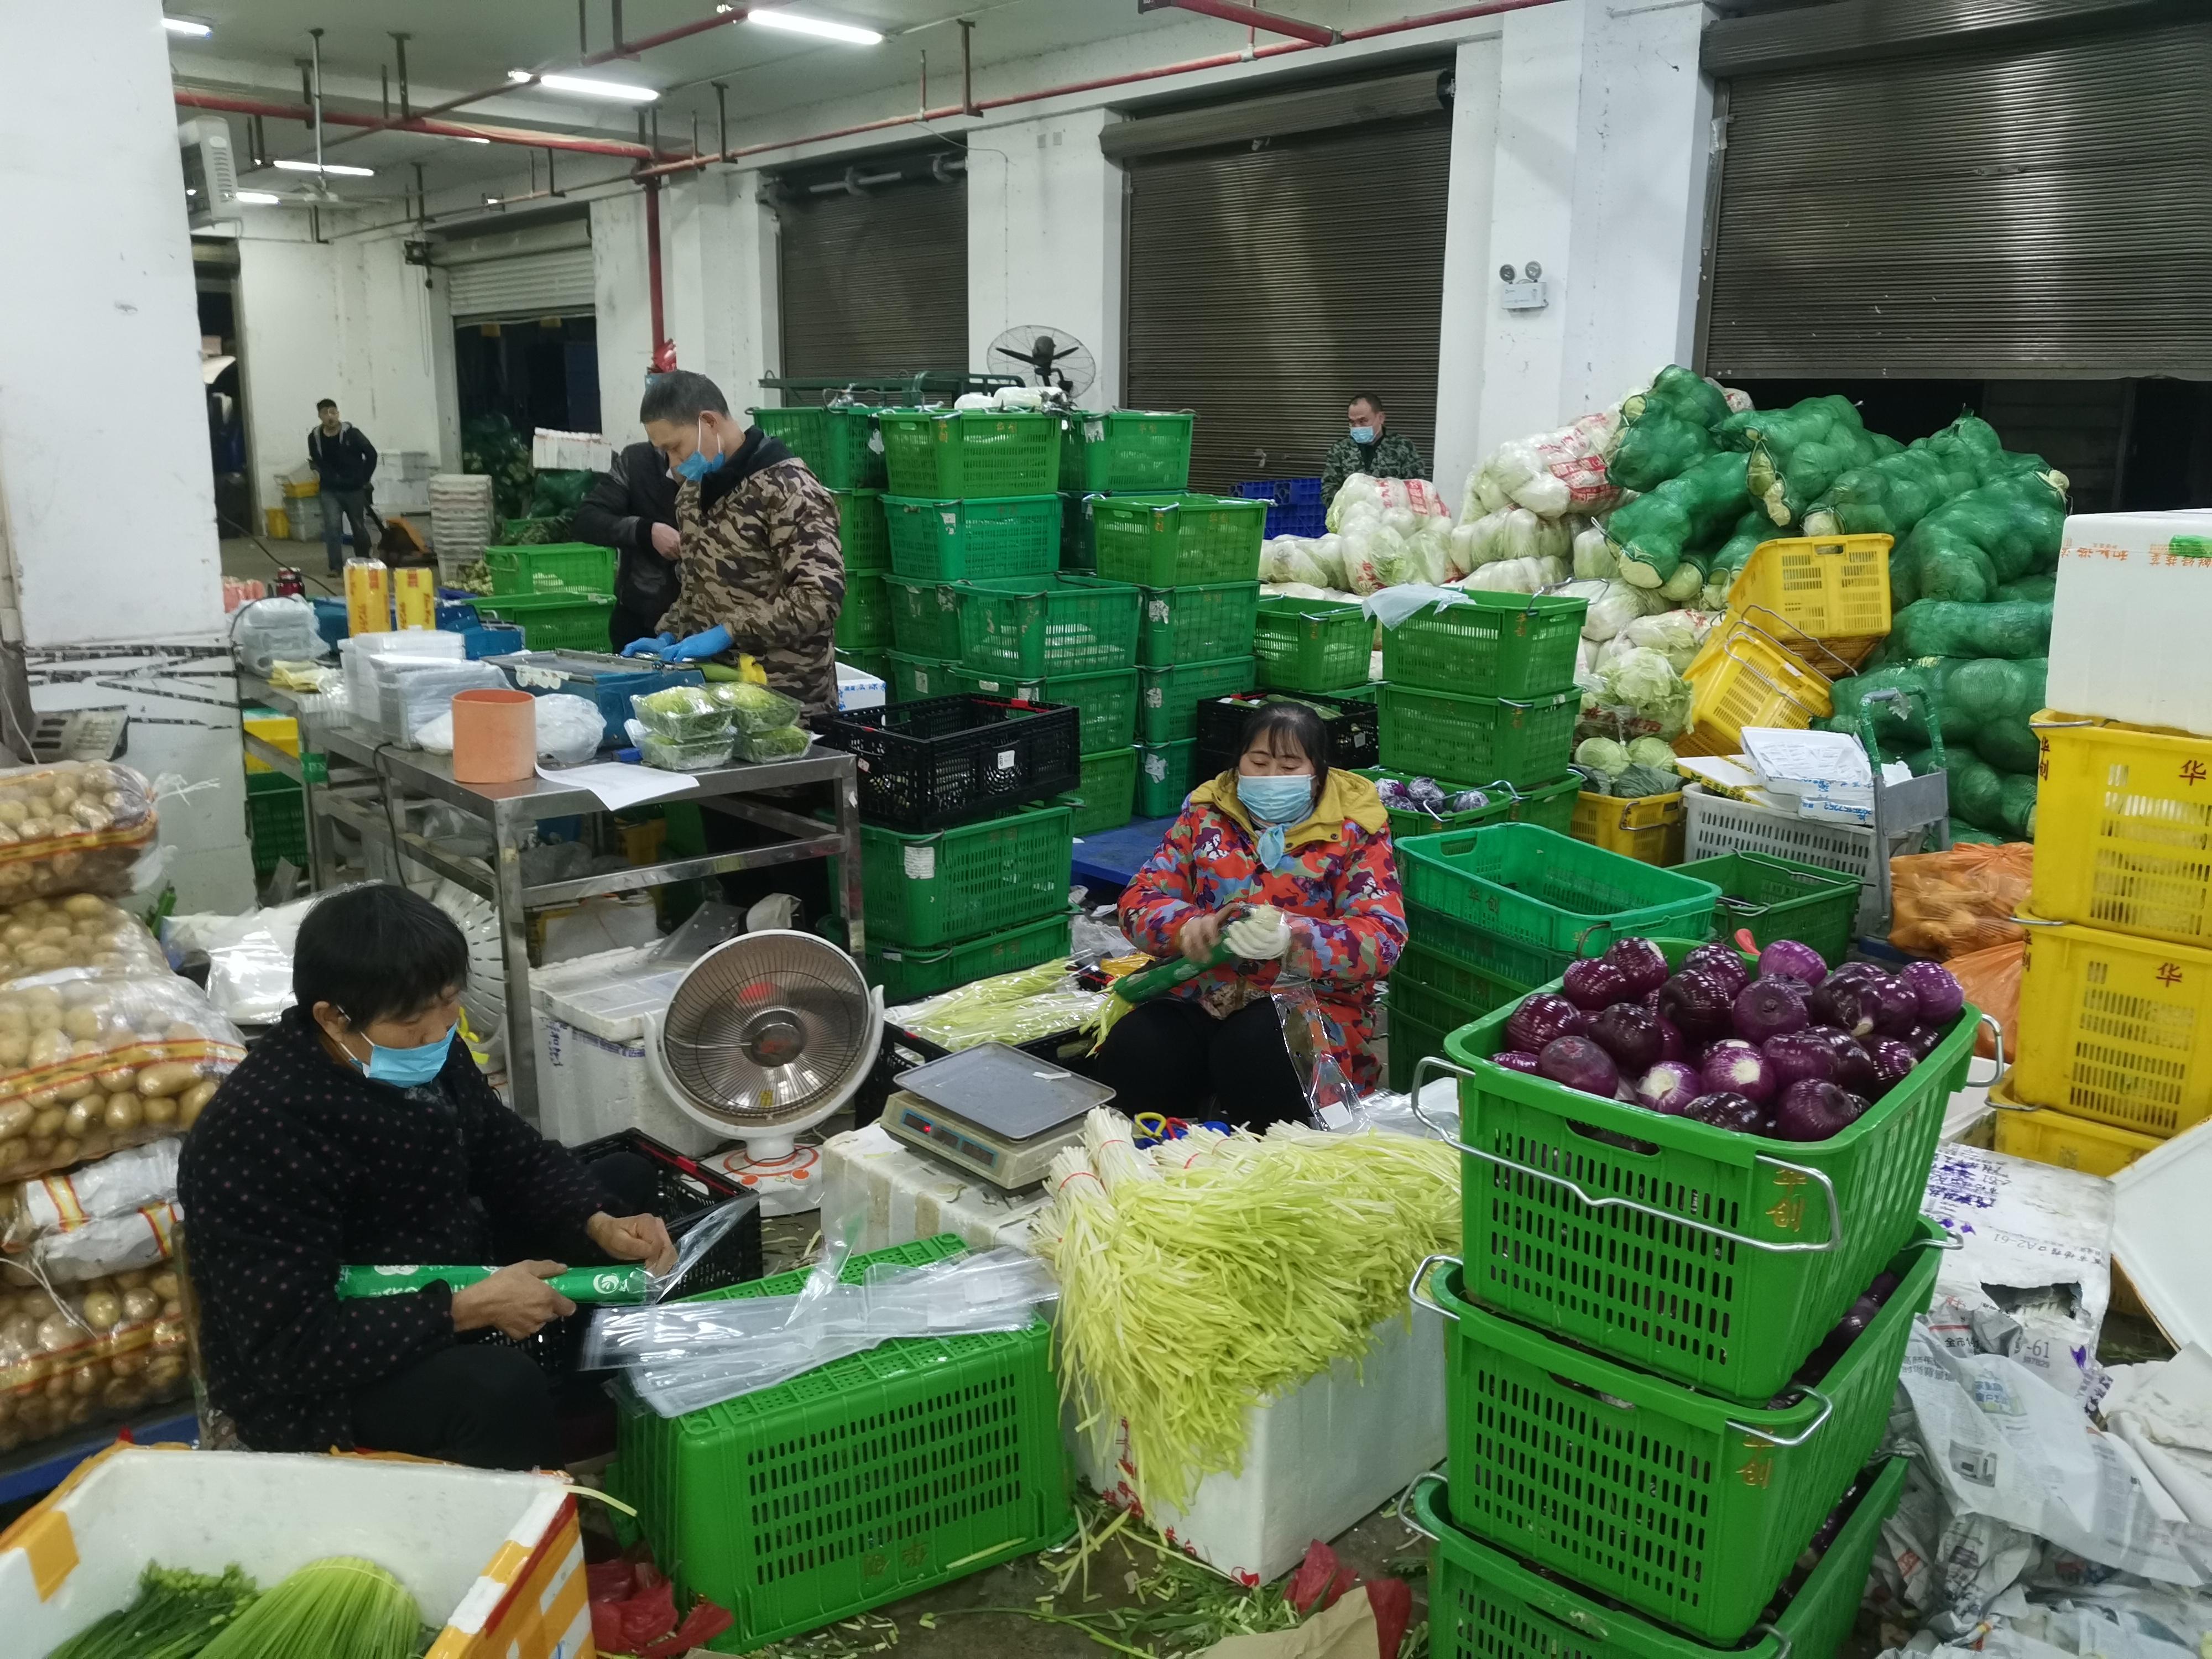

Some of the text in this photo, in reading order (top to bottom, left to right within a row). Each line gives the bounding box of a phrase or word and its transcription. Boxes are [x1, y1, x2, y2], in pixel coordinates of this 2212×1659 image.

[2039, 734, 2051, 782] 华创
[2179, 759, 2207, 786] 华
[2156, 962, 2183, 988] 华
